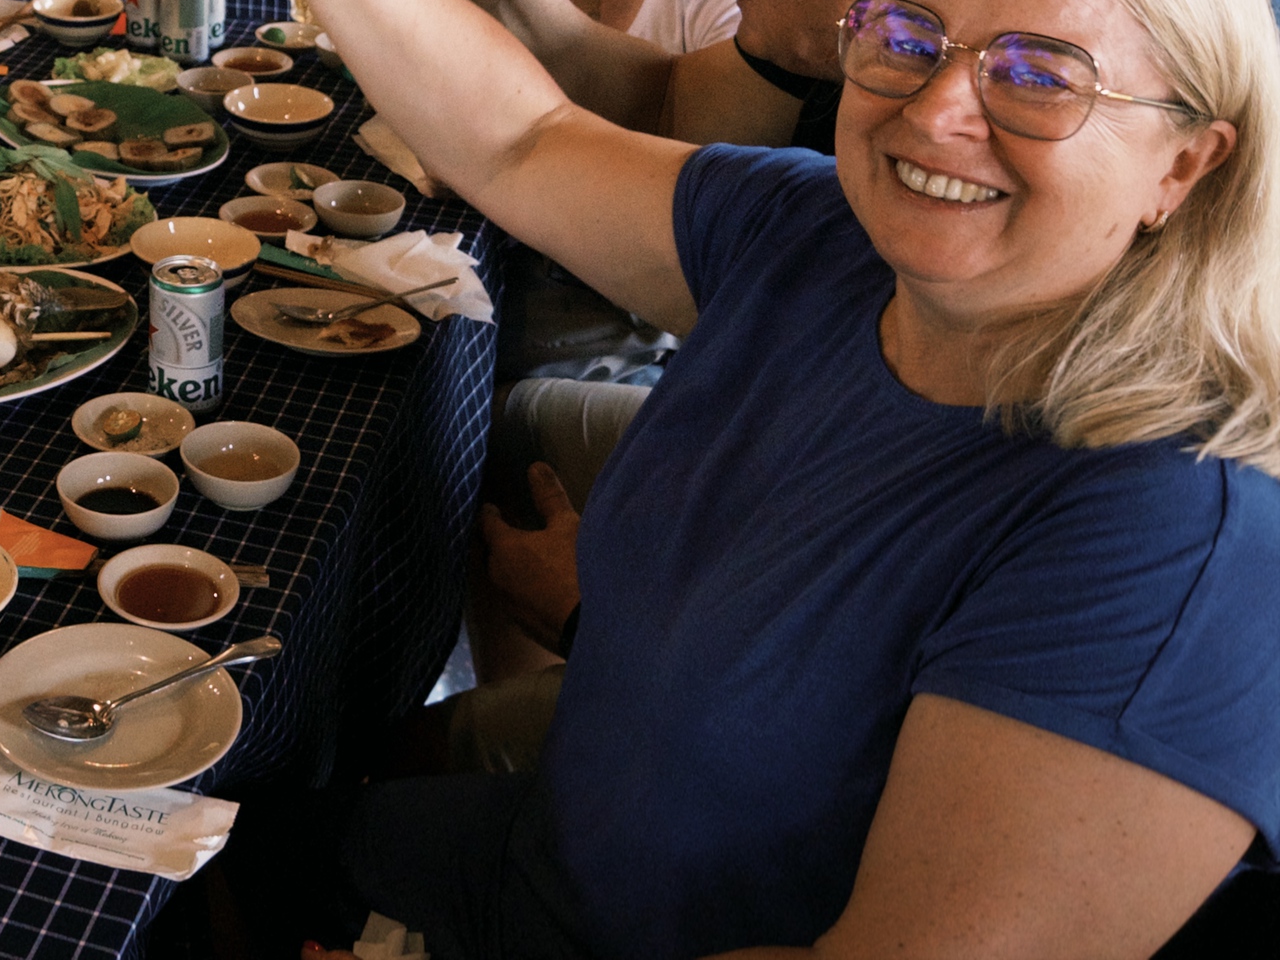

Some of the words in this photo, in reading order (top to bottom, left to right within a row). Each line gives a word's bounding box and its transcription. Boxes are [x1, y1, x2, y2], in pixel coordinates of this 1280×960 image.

[159, 298, 204, 352] SILVER
[2, 784, 80, 818] Restaurant
[96, 814, 166, 837] Bungalow
